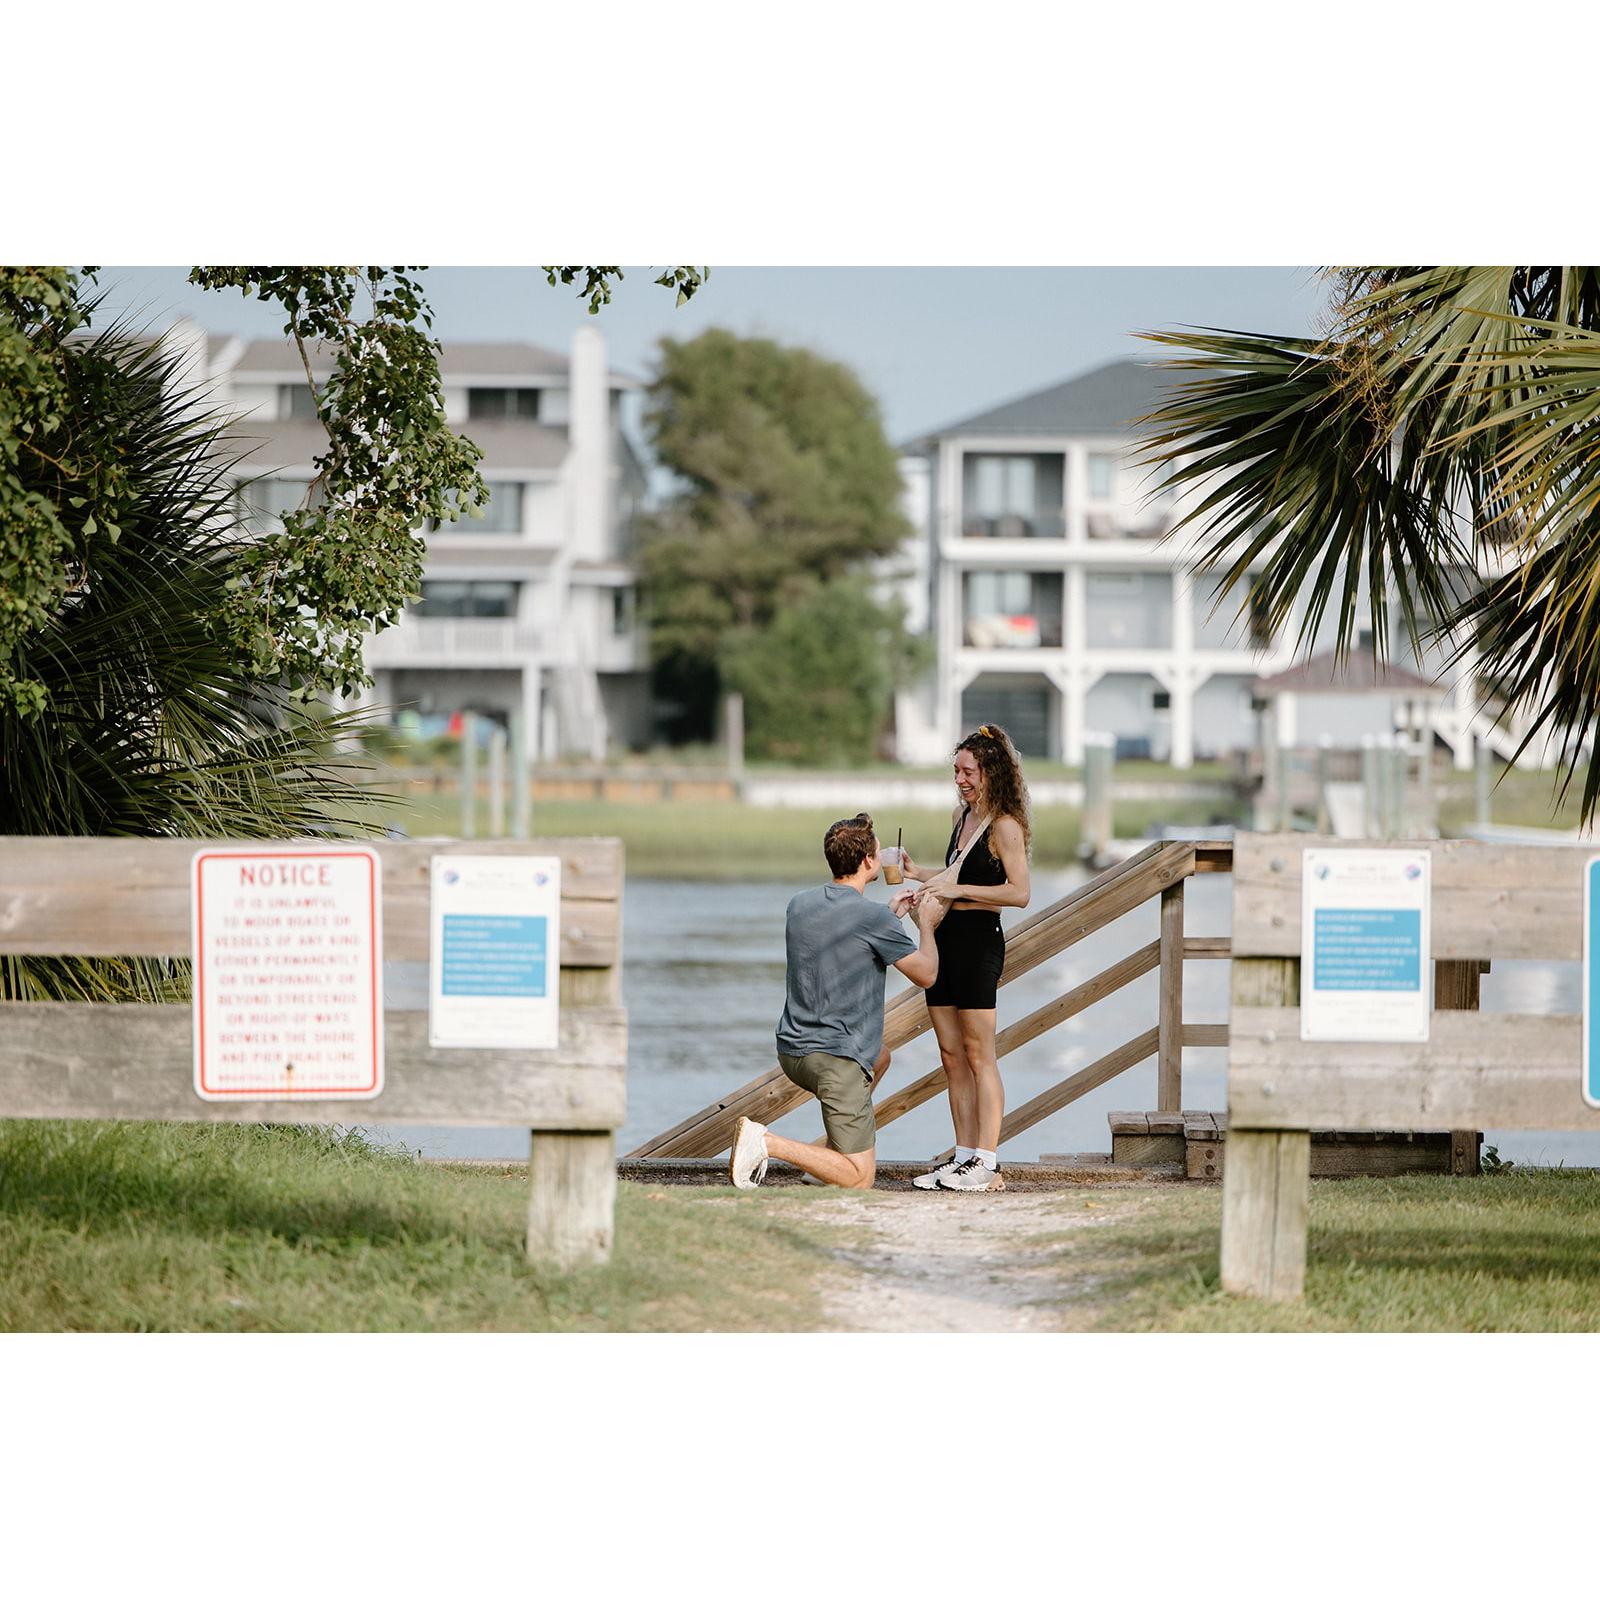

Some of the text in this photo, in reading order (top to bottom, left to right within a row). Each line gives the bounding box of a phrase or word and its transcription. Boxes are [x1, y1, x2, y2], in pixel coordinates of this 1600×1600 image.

[239, 864, 331, 886] NOTICE
[267, 897, 335, 909] UNLAWFUL
[223, 915, 351, 928] TO MOOR BOATS OR
[214, 934, 360, 947] VESSELS OF ANY KIND
[213, 953, 359, 966] EITHER PERMANENTLY
[218, 973, 238, 986] OR
[337, 973, 356, 986] OR
[217, 992, 272, 1005] BEYOND
[226, 1011, 245, 1024] OR
[218, 1031, 356, 1044] BETWEEN THE SHORE
[220, 1051, 247, 1064] AND
[252, 1051, 283, 1064] PIER
[327, 1051, 356, 1064] LINE
